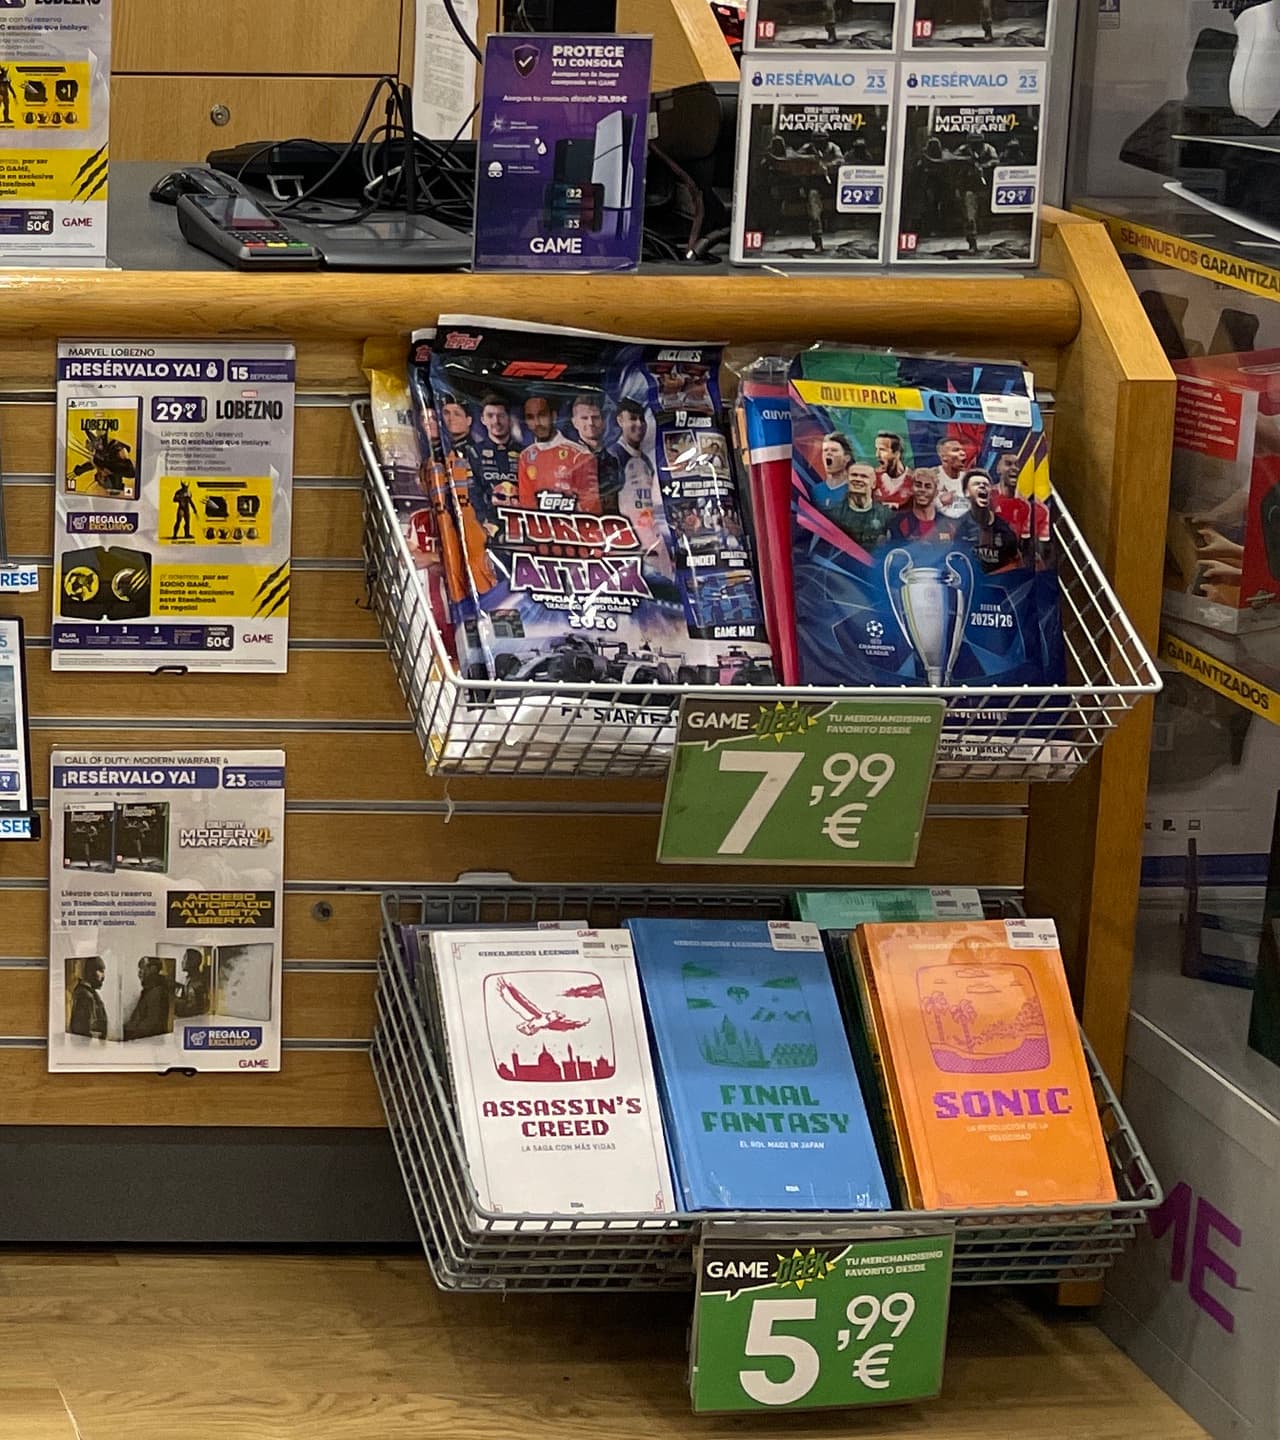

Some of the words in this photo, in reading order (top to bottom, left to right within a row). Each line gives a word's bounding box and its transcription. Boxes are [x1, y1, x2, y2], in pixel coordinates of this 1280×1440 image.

[553, 45, 624, 58] PROTEGE
[552, 59, 566, 67] TU
[569, 59, 623, 68] CONSOLA
[530, 238, 582, 254] GAME
[1121, 228, 1198, 264] SEMINUEVOS
[1201, 255, 1280, 292] GARANTIZA
[65, 362, 170, 379] ¡RESÉRVALO
[173, 363, 201, 377] YA!
[232, 366, 248, 379] 15
[820, 386, 898, 405] MULTIPACK
[216, 400, 283, 420] LOBEZNO
[568, 615, 616, 630] 2026
[243, 634, 273, 644] GAME
[714, 627, 737, 637] GAME
[739, 626, 755, 637] MAT
[1168, 642, 1269, 709] GARANTIZADOS
[65, 756, 87, 764] CALL
[89, 756, 102, 764] OF
[104, 756, 131, 764] DUTY:
[133, 756, 174, 764] MODERN
[176, 756, 222, 764] WARFARE
[62, 770, 163, 787] ¡RESÉRVALO
[167, 770, 195, 785] YA!
[226, 774, 246, 787] 23
[239, 1059, 269, 1068] GAME
[720, 1085, 820, 1106] FINAL
[932, 1088, 1072, 1119] SONIC
[483, 1096, 641, 1117] ASSASSIN'S
[521, 1120, 609, 1137] CREED
[701, 1112, 849, 1134] FANTASY
[574, 1142, 591, 1150] MÁS
[706, 1261, 769, 1281] GAME
